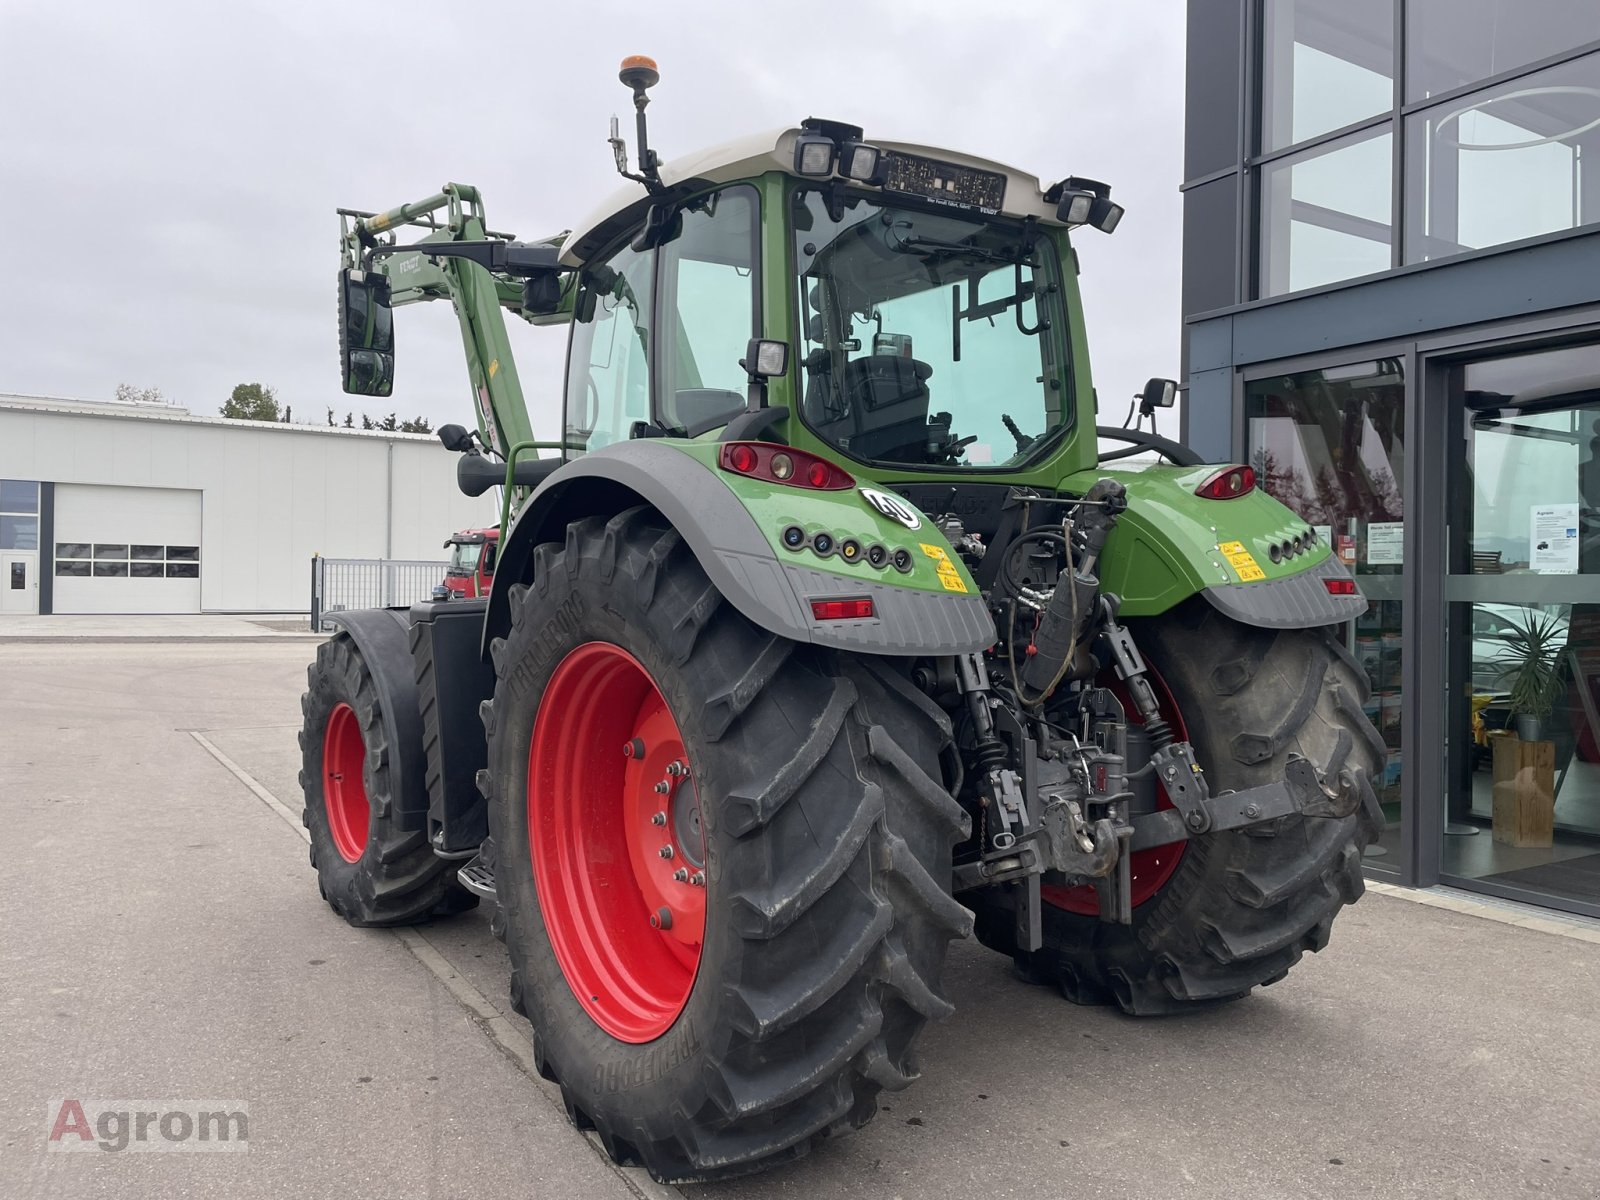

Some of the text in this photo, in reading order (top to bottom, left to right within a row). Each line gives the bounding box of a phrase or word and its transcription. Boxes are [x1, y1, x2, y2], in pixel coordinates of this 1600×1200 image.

[980, 207, 998, 215] FENDT
[400, 255, 420, 274] FENDT
[869, 494, 913, 522] 40
[507, 589, 586, 698] TRELLEBORG
[594, 1019, 701, 1095] TRELLEBORG
